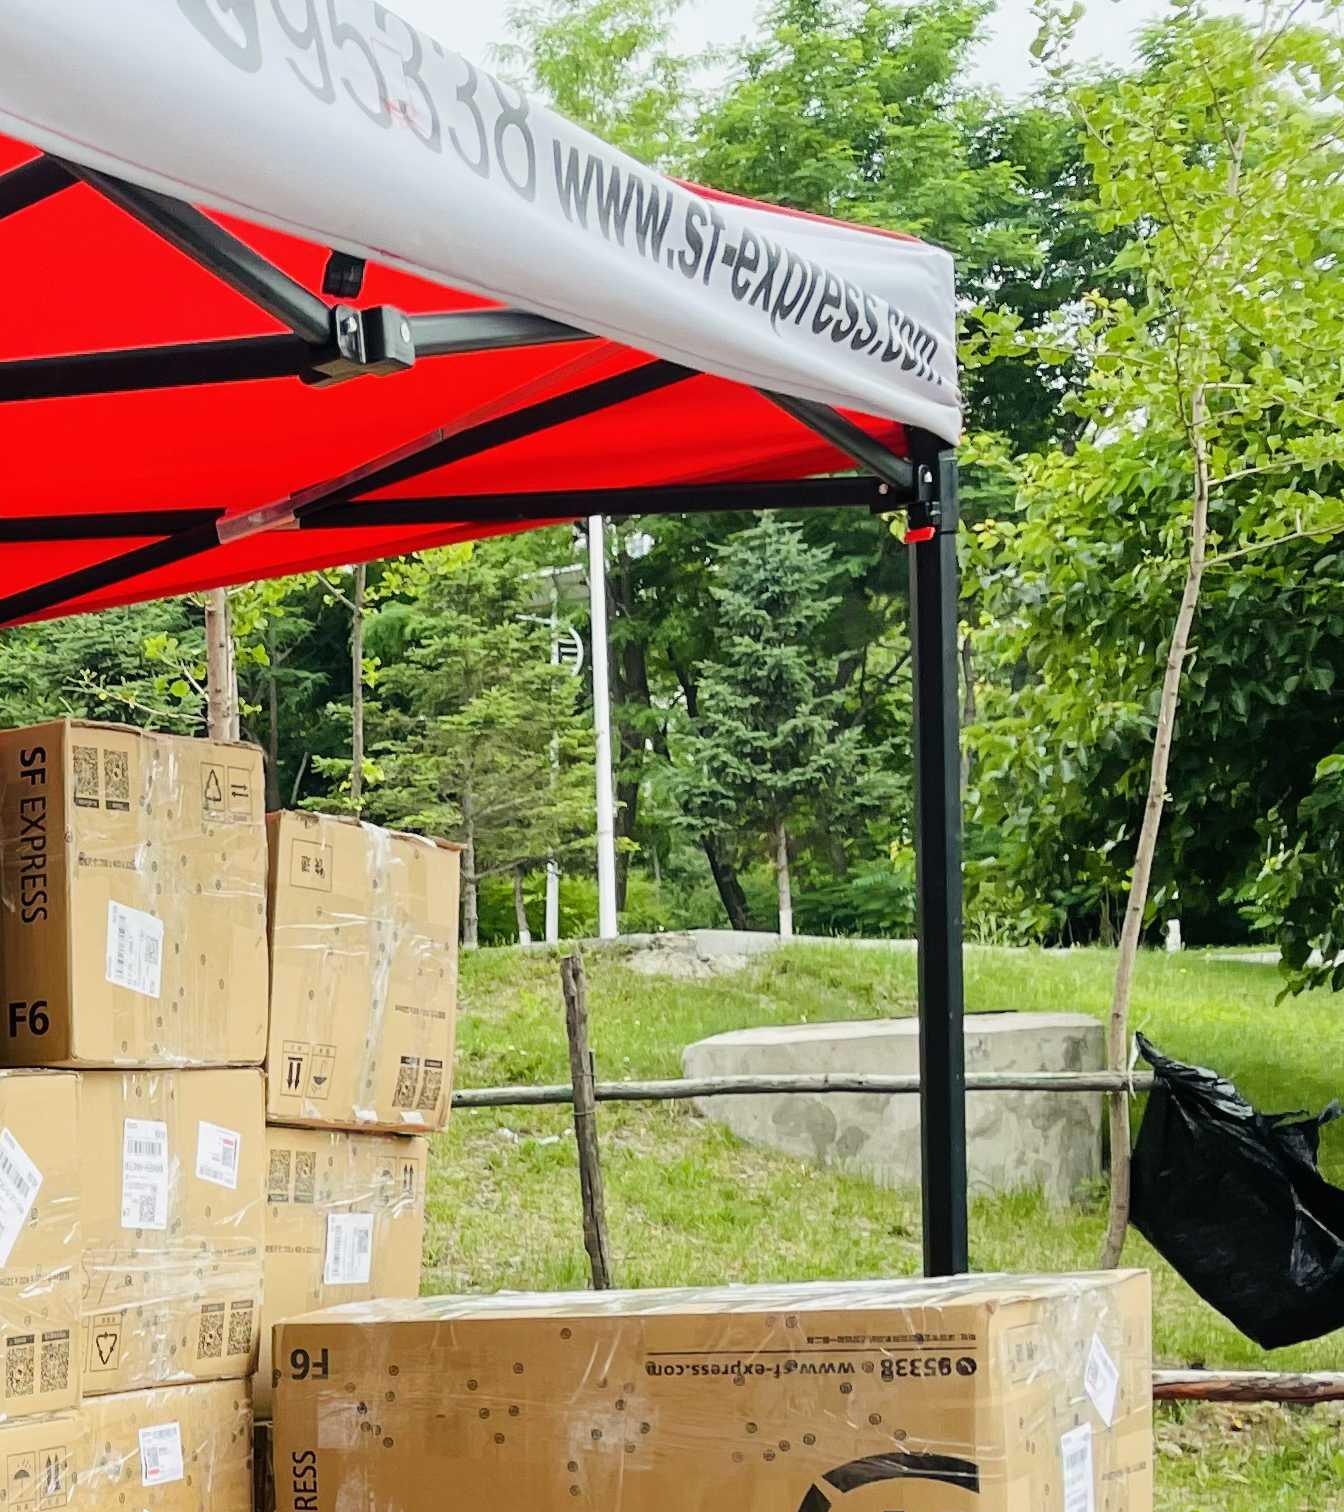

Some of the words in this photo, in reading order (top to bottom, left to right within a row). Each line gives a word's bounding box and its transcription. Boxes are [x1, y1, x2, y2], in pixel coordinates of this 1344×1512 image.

[19, 746, 47, 785] SF
[20, 795, 49, 924] EXPRESS
[10, 1001, 50, 1037] F6
[290, 1348, 330, 1381] F6
